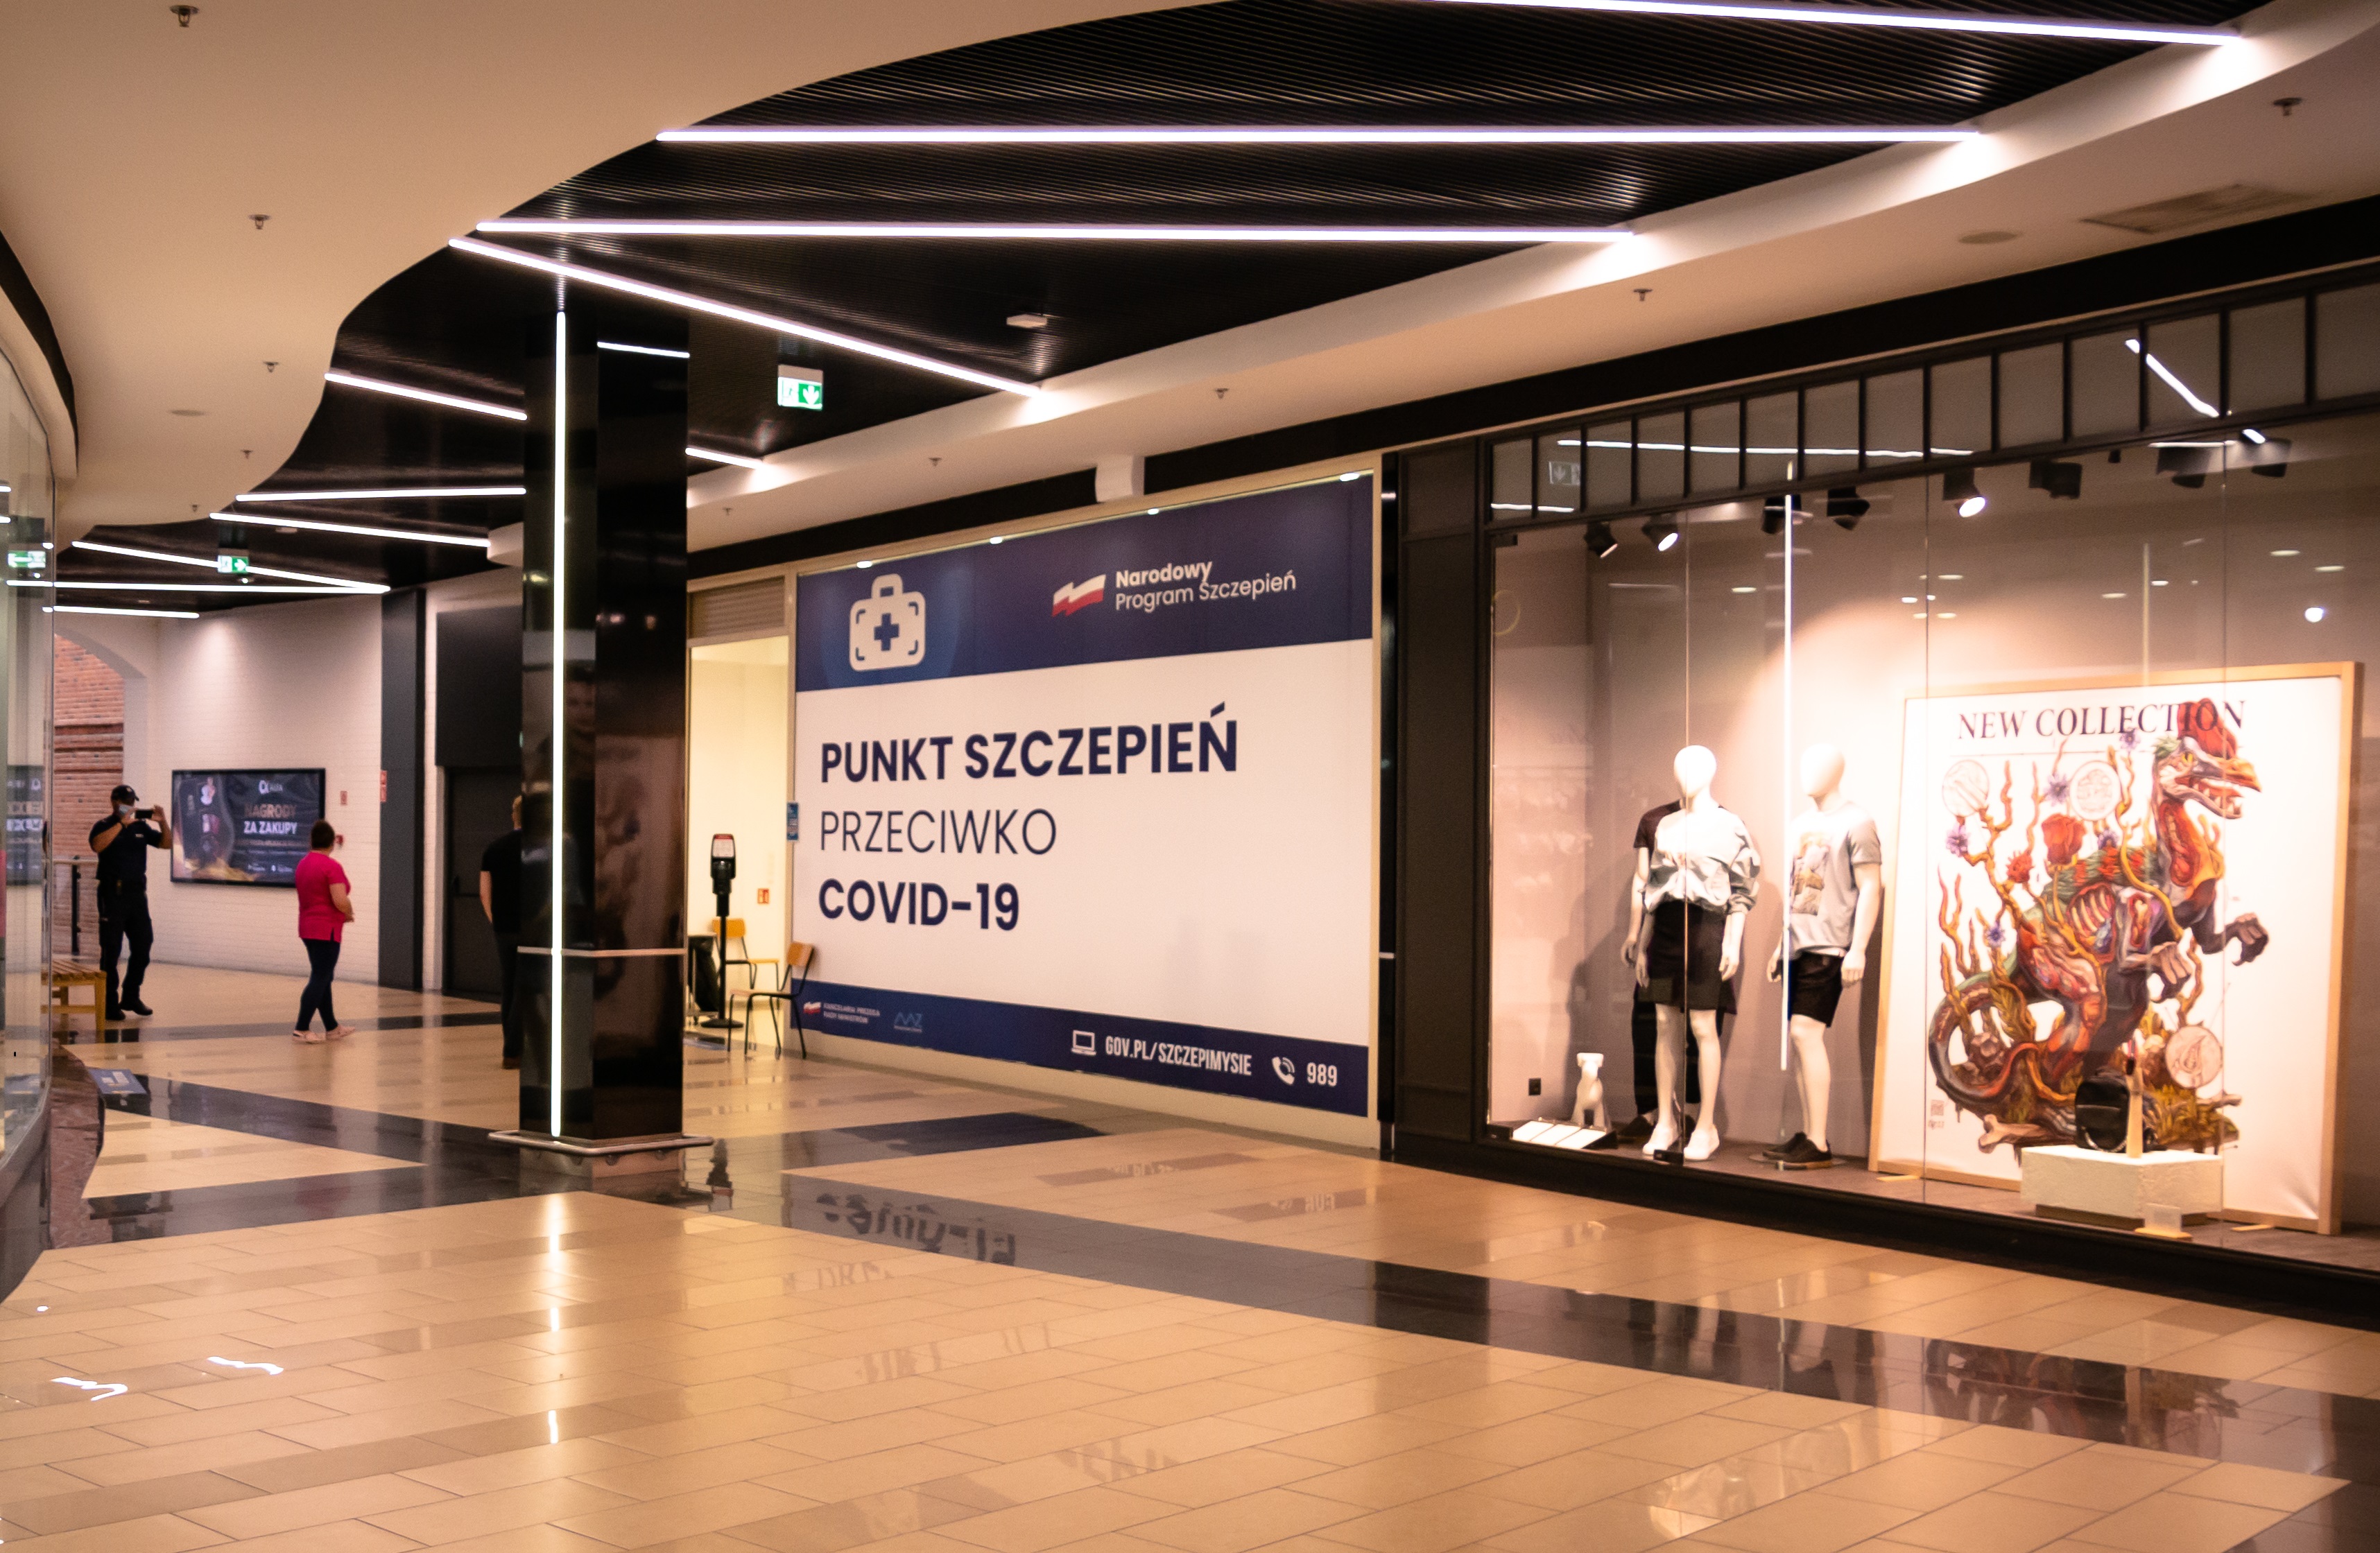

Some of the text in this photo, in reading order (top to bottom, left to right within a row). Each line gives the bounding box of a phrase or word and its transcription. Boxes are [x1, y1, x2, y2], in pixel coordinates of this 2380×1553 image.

[1115, 561, 1213, 588] Narodowy
[1115, 569, 1296, 613] Program Szczepień
[1958, 700, 2246, 740] NEW COLLECTION
[821, 702, 1237, 783] PUNKT SZCZEPIEŃ
[243, 821, 258, 833] ZA
[821, 808, 1057, 856] PRZECIWKO
[819, 878, 1019, 931] COVID-19
[1105, 1036, 1252, 1076] GOV.PL/SZCZEPIMYSIE
[1307, 1061, 1338, 1086] 989
